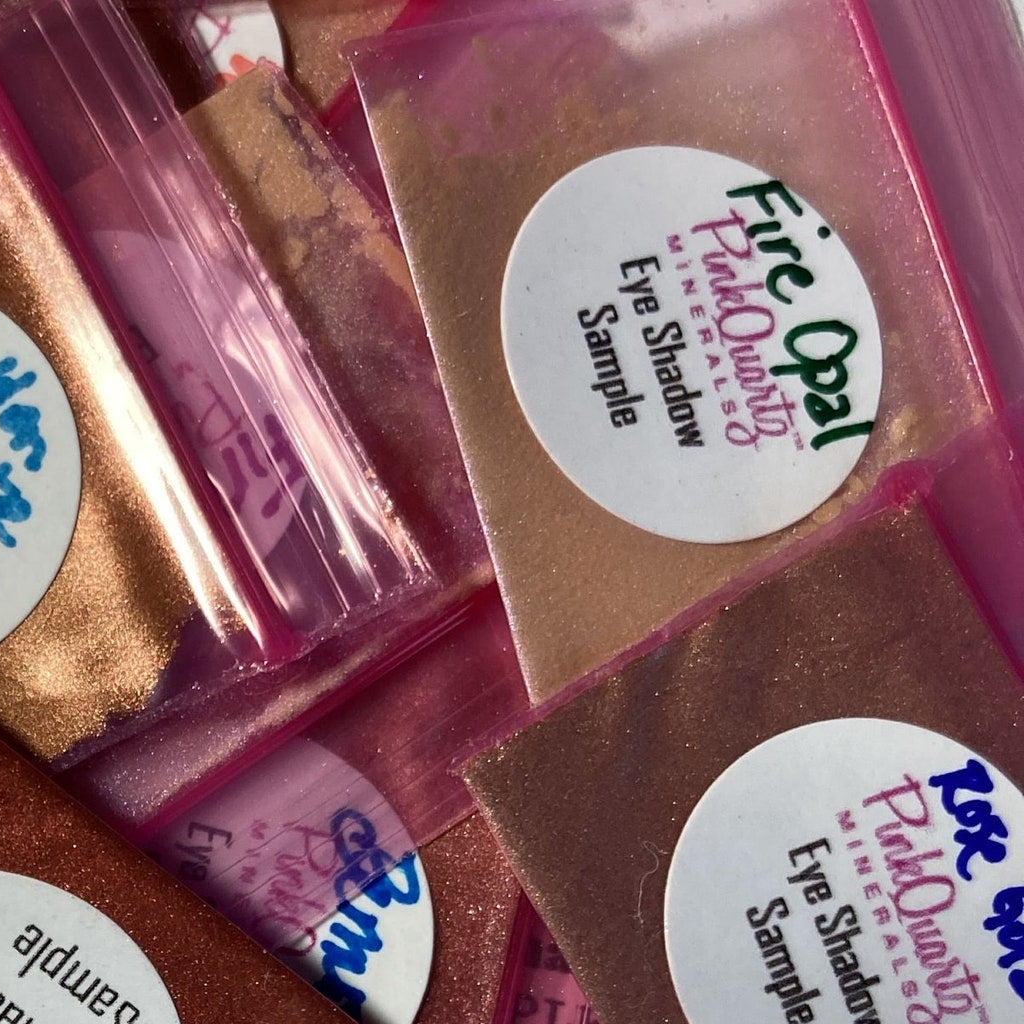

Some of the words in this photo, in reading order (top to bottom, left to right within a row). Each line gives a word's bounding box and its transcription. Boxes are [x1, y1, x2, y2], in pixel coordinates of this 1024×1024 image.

[726, 180, 832, 305] Fire
[578, 304, 645, 428] Sample
[619, 255, 660, 315] Eye
[642, 321, 705, 448] Shadow
[665, 233, 736, 416] MINERALS
[769, 319, 875, 451] Opal
[787, 838, 832, 905] Eye
[836, 809, 919, 998] MINERALS
